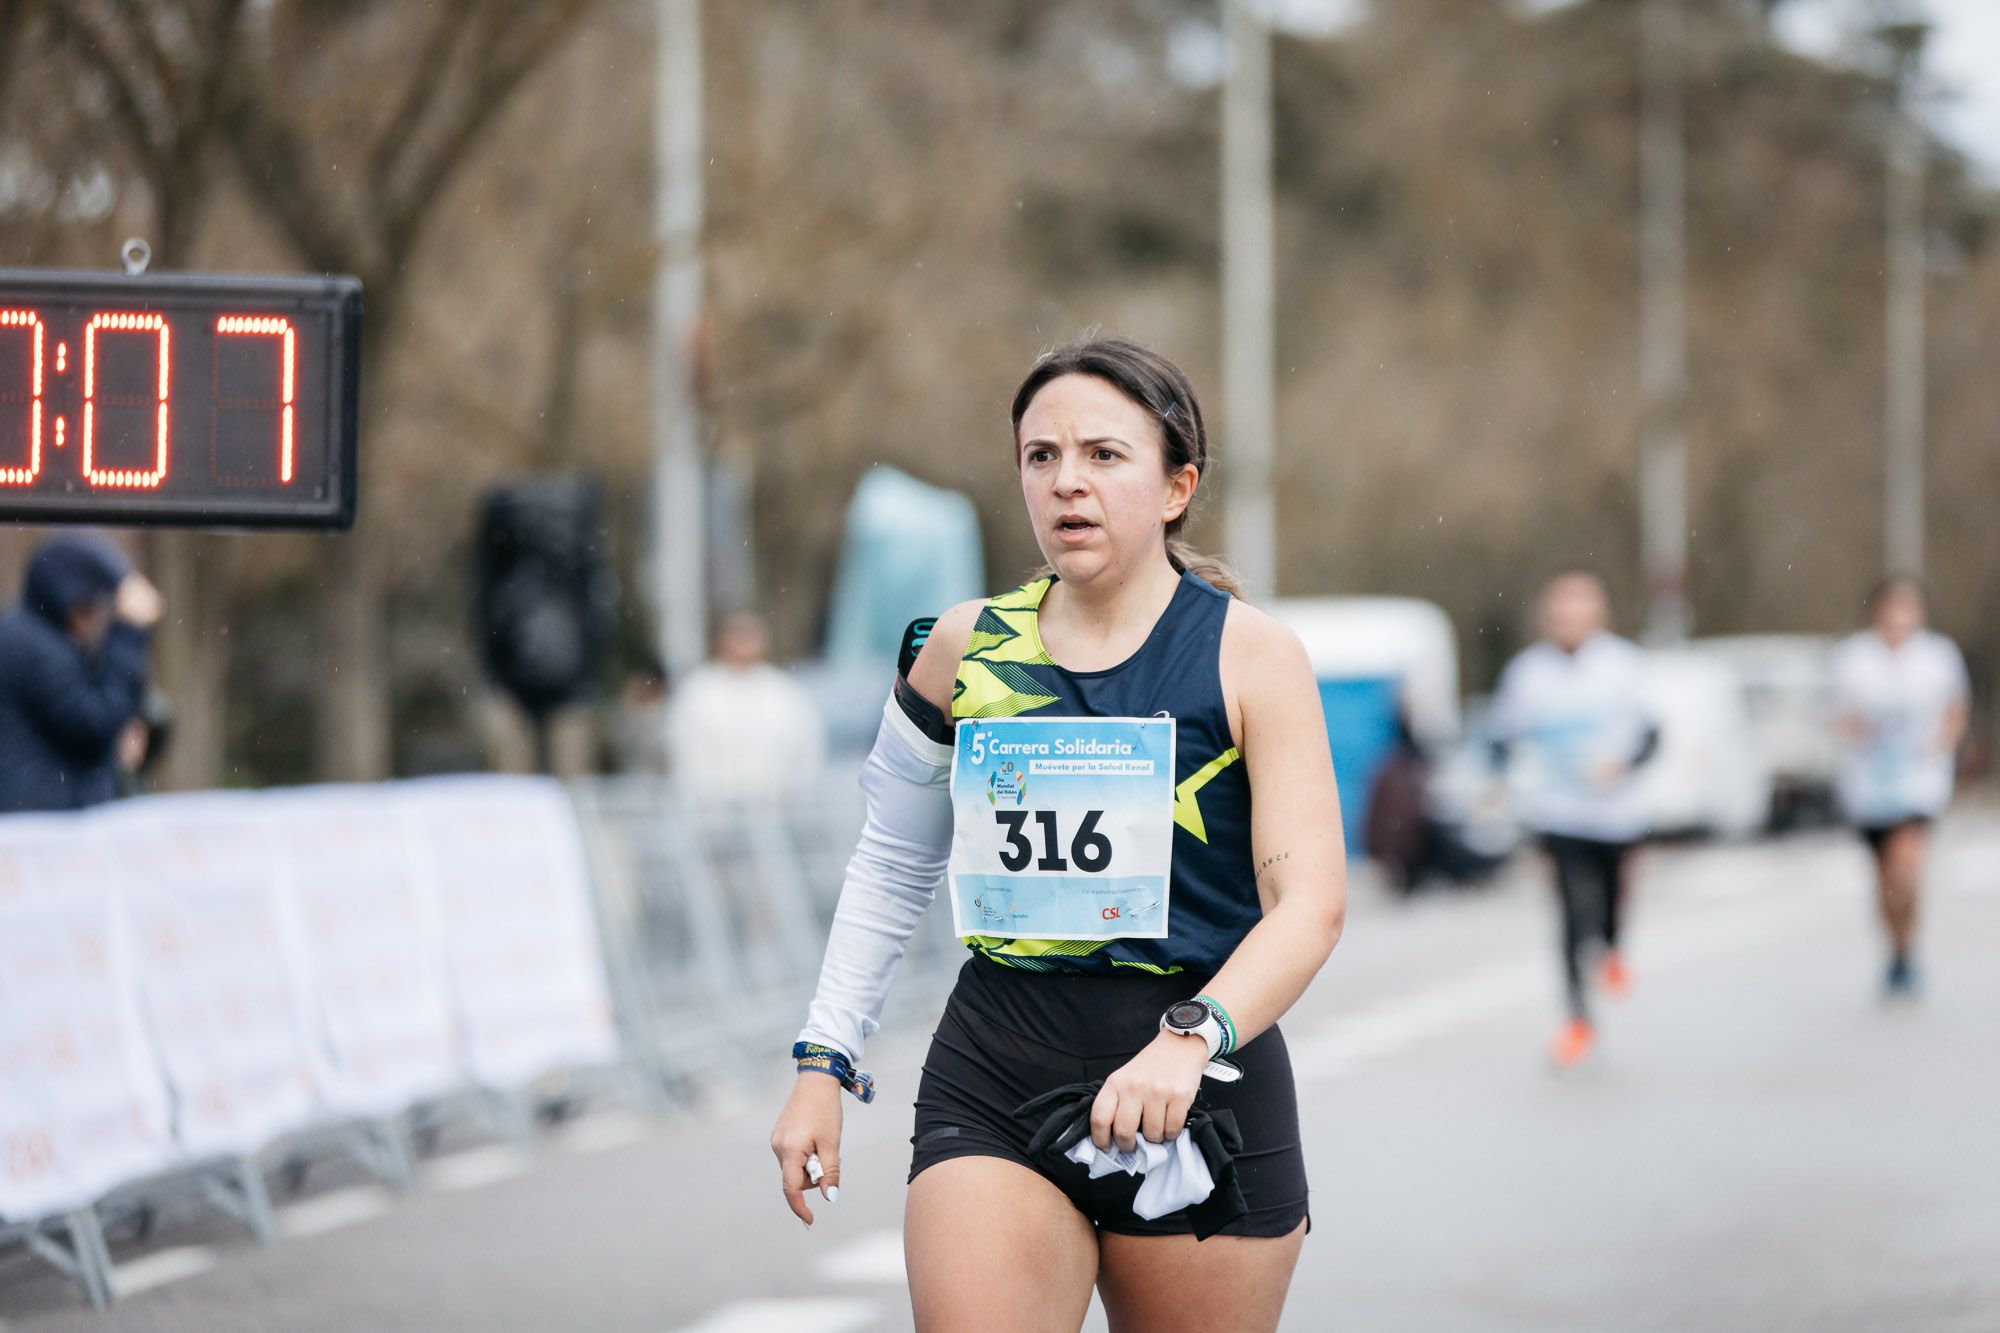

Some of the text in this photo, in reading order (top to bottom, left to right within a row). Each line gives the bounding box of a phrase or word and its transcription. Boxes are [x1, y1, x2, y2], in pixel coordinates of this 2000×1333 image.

[989, 738, 1049, 755] Carrera
[1054, 738, 1132, 755] Solidaria
[1035, 762, 1150, 772] Muévete por la Salud Renal
[995, 810, 1112, 872] 316
[1102, 907, 1121, 920] CSL
